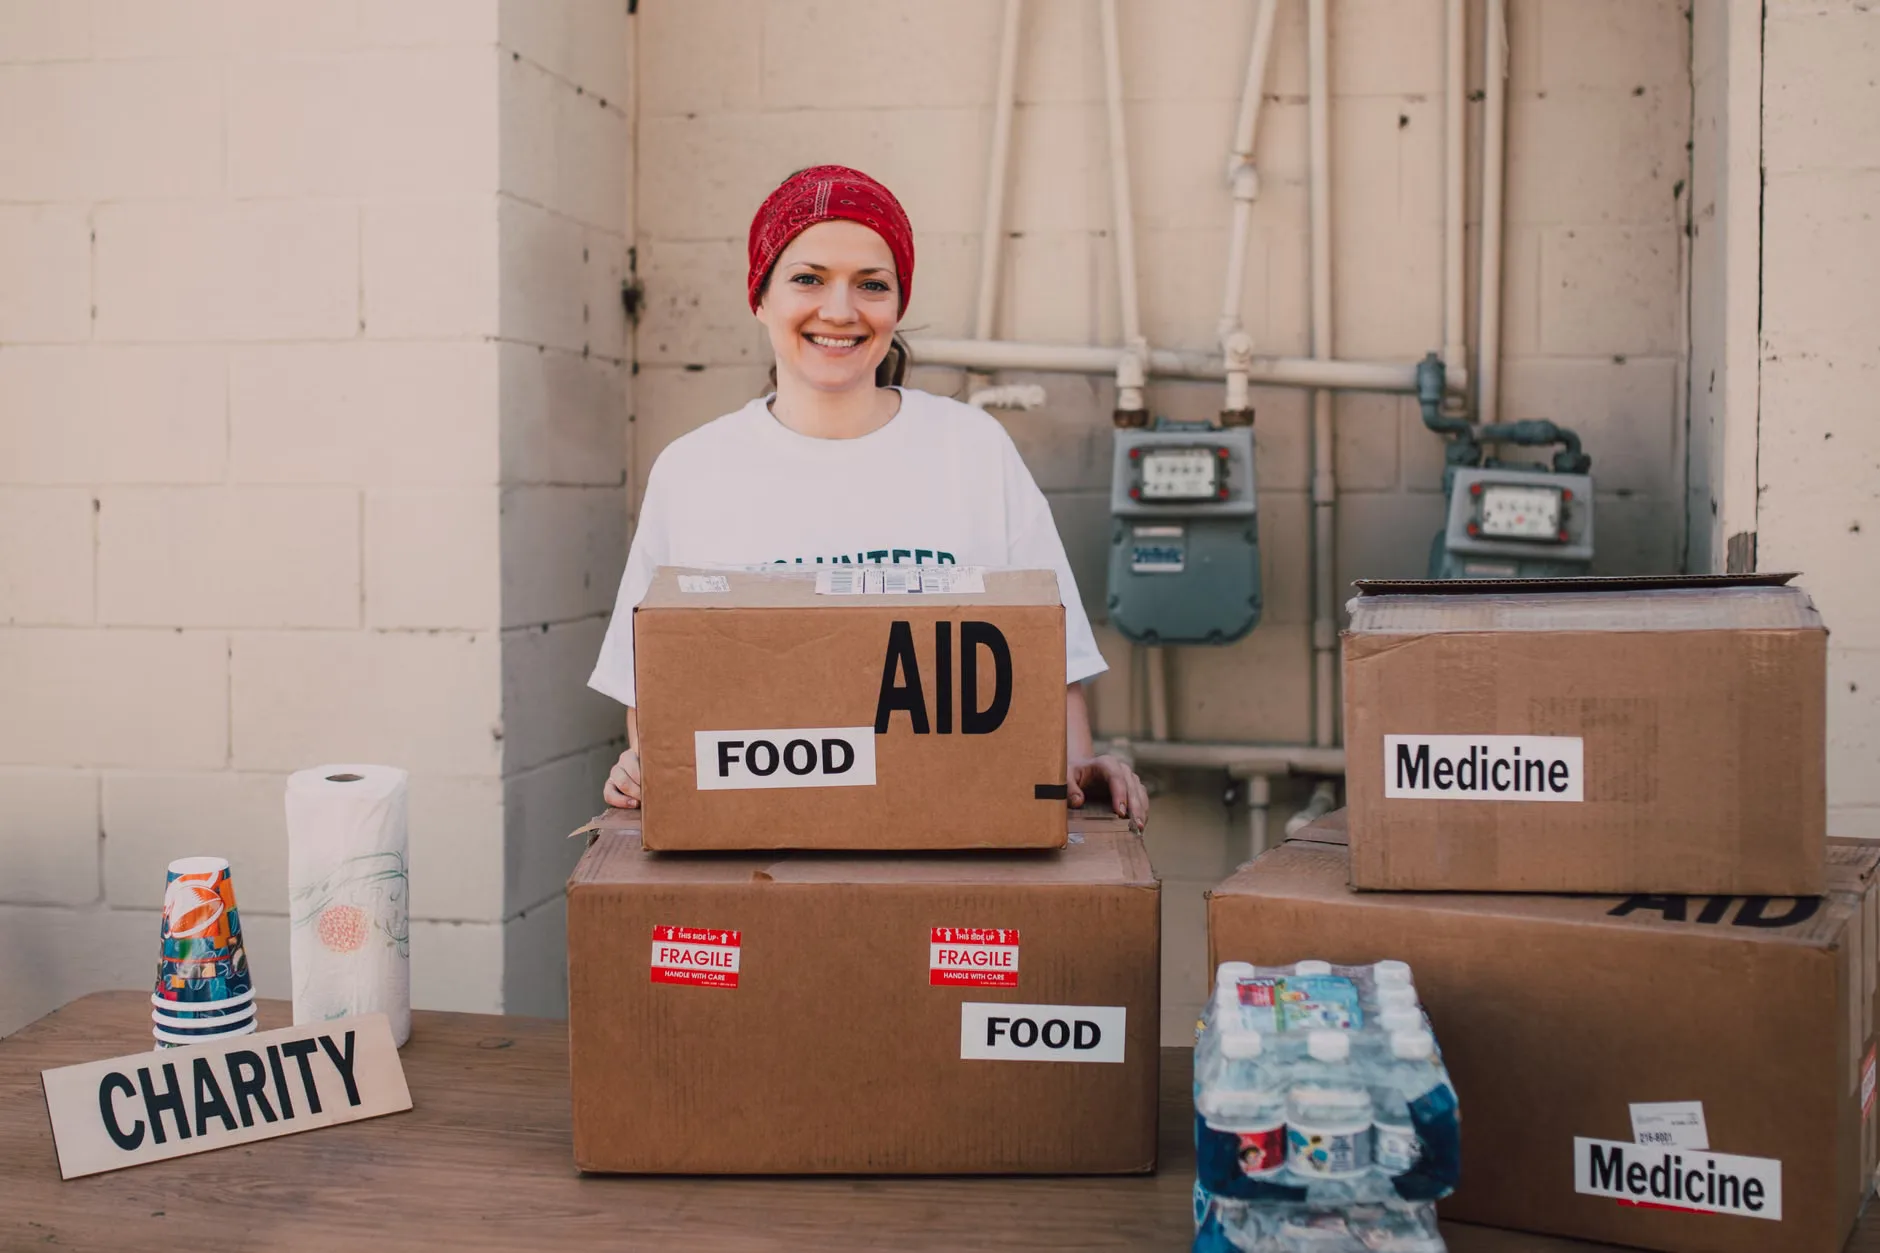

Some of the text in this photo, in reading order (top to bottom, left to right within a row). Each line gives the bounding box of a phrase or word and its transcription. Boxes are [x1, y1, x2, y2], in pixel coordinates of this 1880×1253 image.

[874, 621, 1013, 735] AID
[717, 738, 855, 777] FOOD
[1396, 743, 1569, 793] Medicine
[660, 948, 733, 967] FRAGILE
[692, 972, 706, 980] WITH
[938, 950, 1011, 966] FRAGILE
[986, 1016, 1102, 1050] FOOD
[99, 1030, 362, 1151] CHARITY
[1589, 1143, 1765, 1212] Medicine
